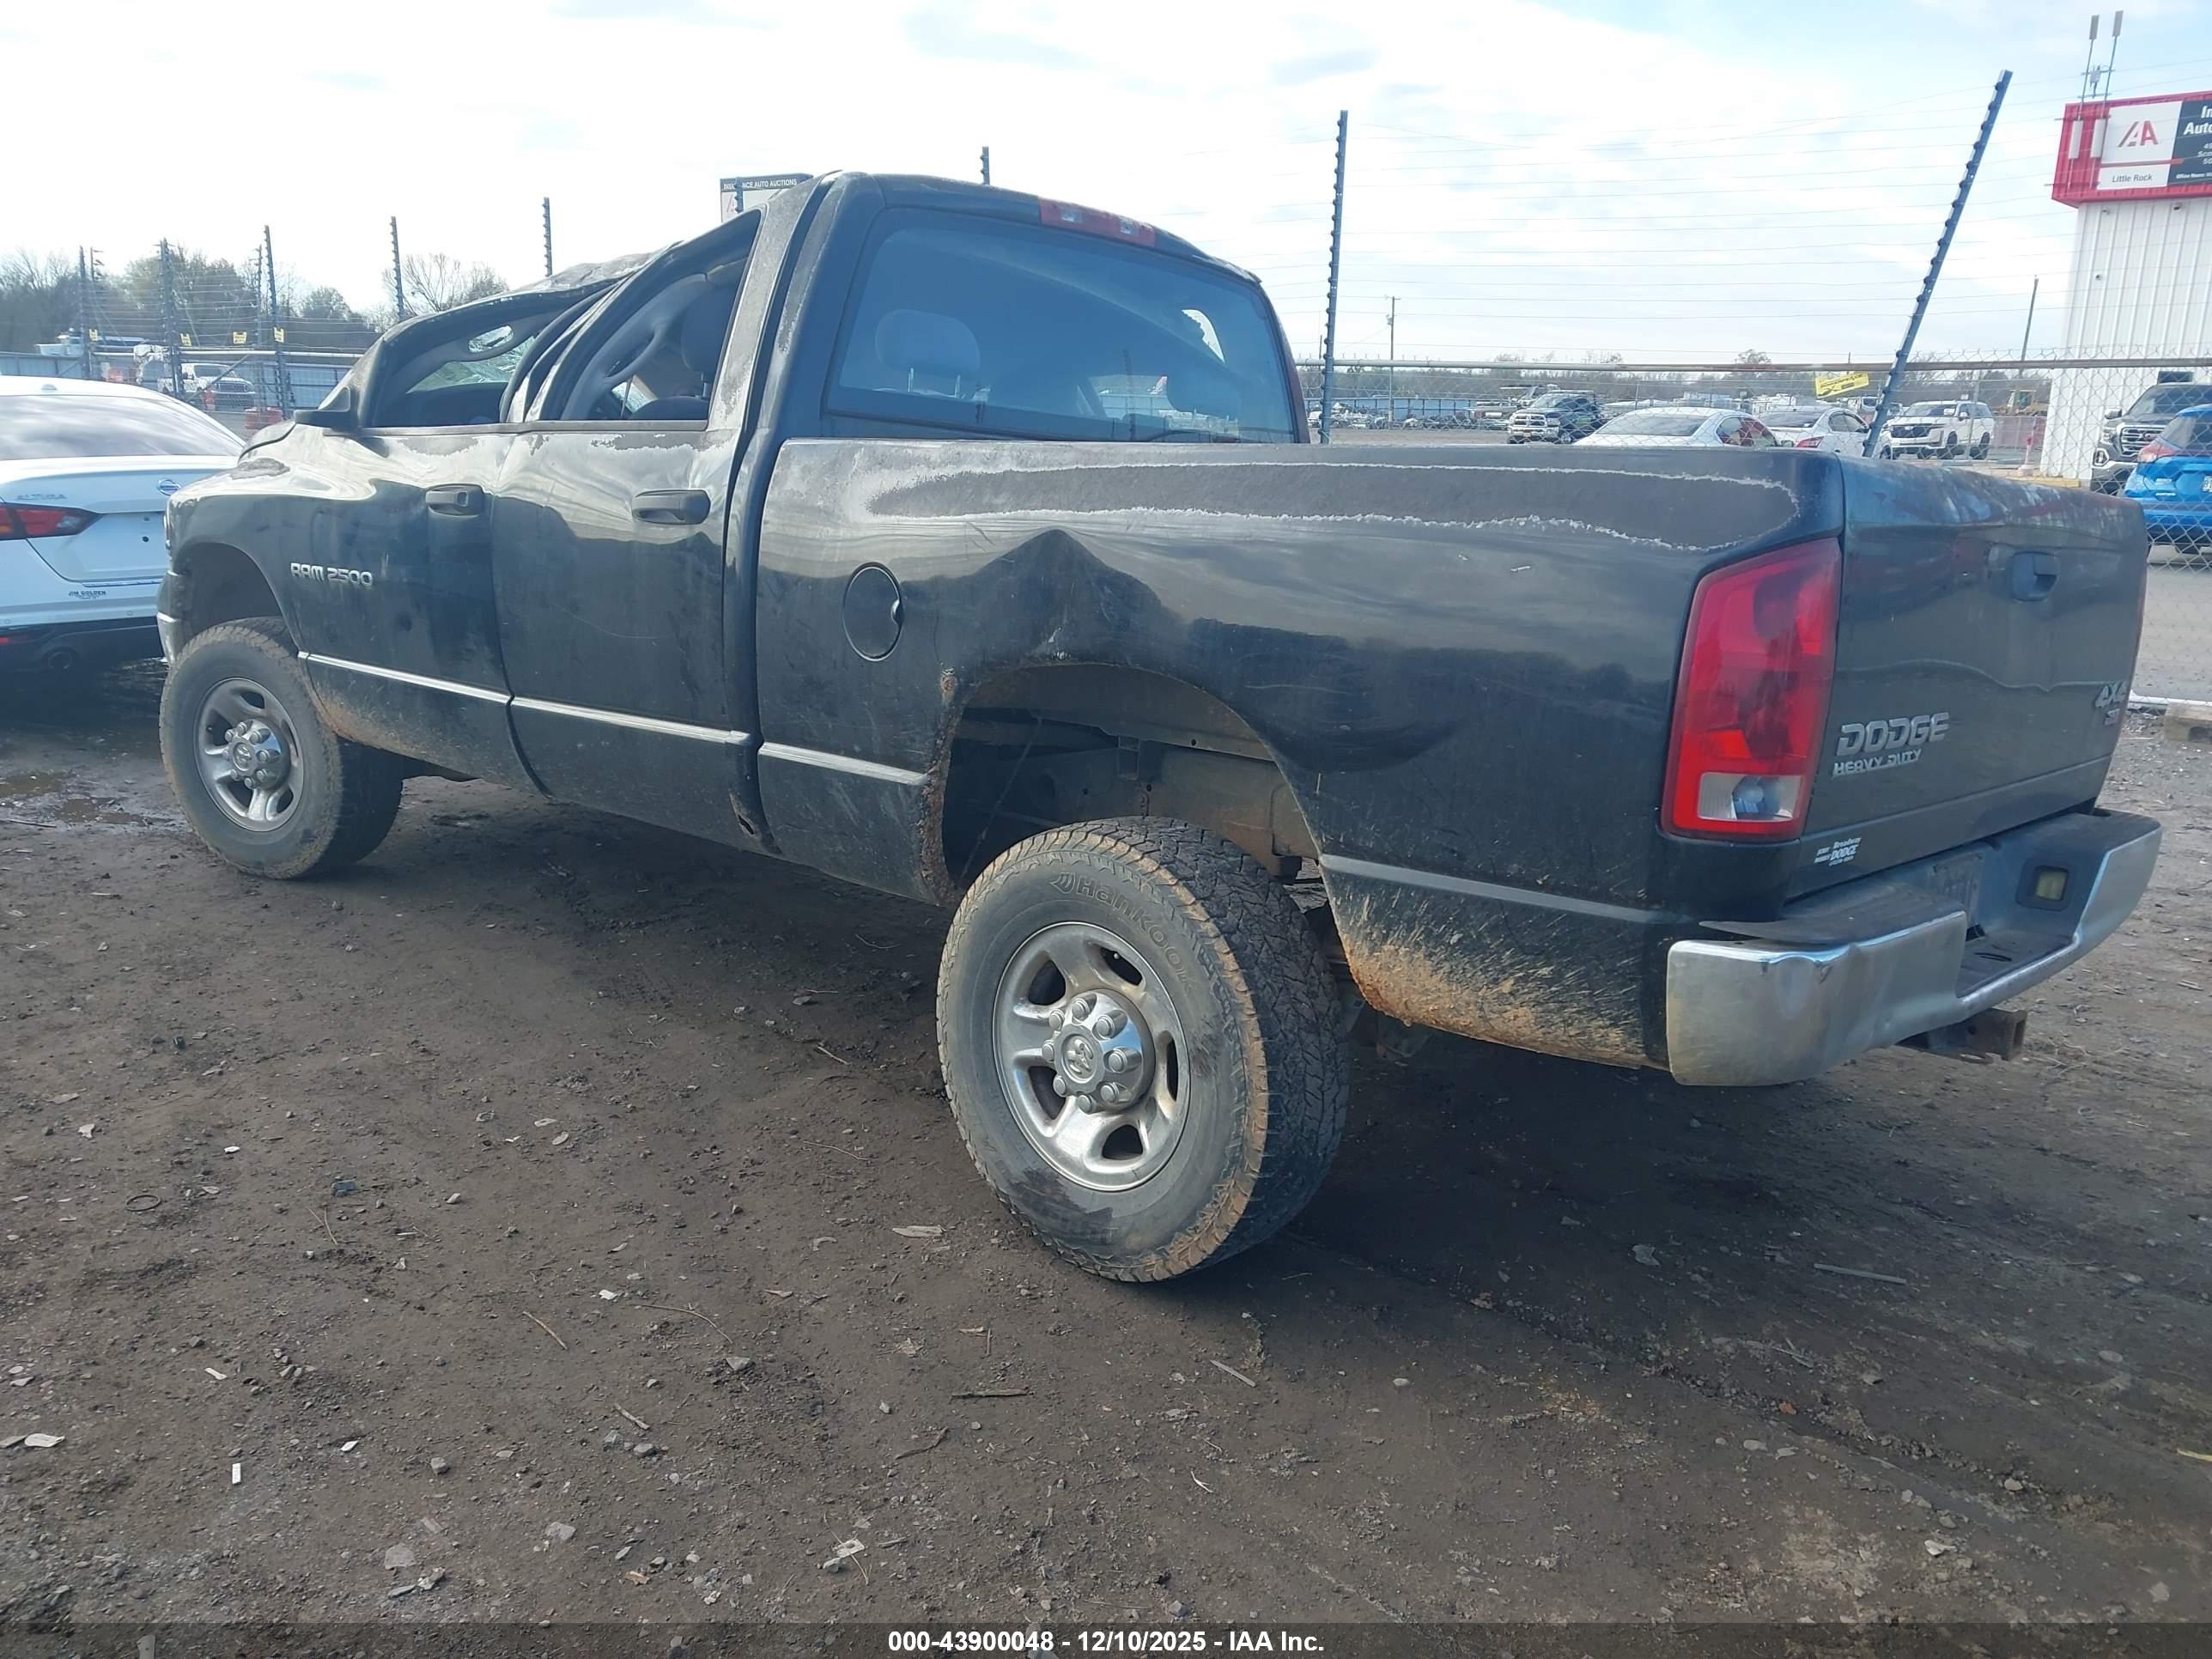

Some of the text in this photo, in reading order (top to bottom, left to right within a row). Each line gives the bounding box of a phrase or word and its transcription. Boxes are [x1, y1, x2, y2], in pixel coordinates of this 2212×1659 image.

[769, 179, 798, 187] AUCTIONS
[2112, 173, 2154, 183] Little Rock
[290, 562, 374, 587] RAM 2500
[1837, 712, 1949, 757] DODGE
[1832, 749, 1923, 779] HEAVY DUTY
